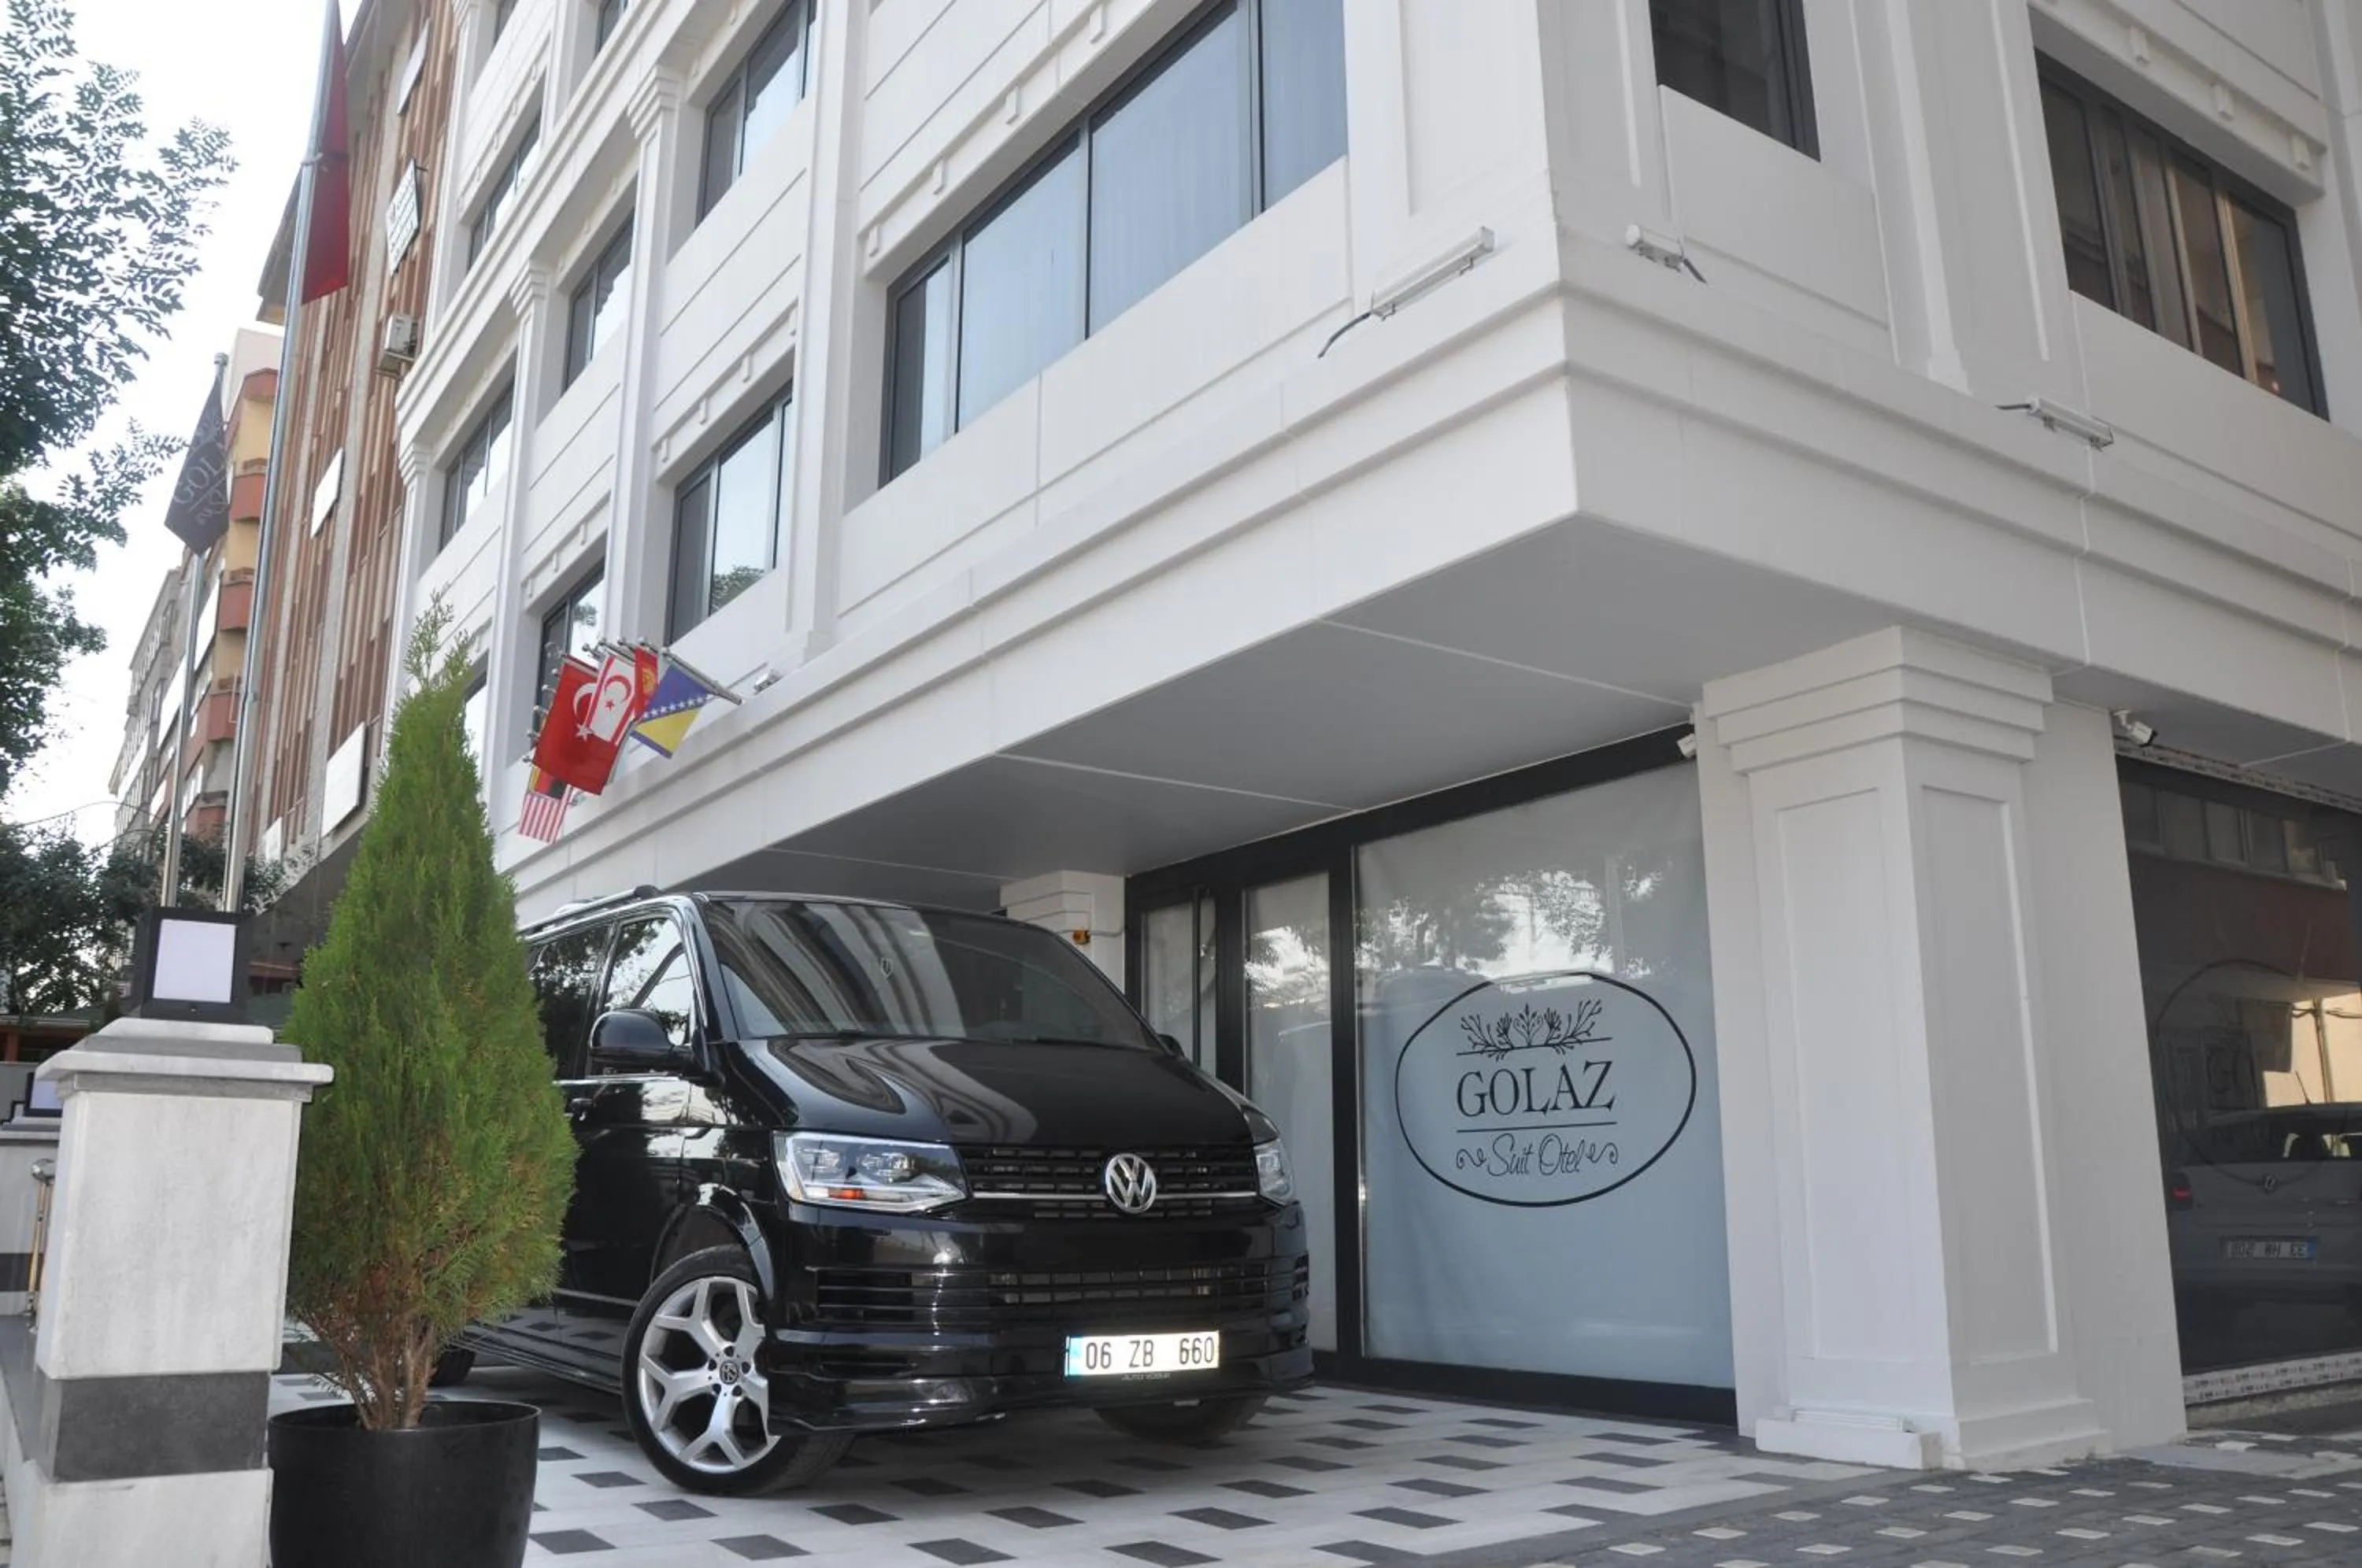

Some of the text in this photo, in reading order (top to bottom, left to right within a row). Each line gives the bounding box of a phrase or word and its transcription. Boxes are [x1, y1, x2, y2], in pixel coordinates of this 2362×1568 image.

[173, 446, 226, 504] GOL
[1457, 1060, 1616, 1117] GOLAZ
[1487, 1133, 1585, 1177] Suit Otel
[1086, 1337, 1214, 1370] 06 ZB 660
